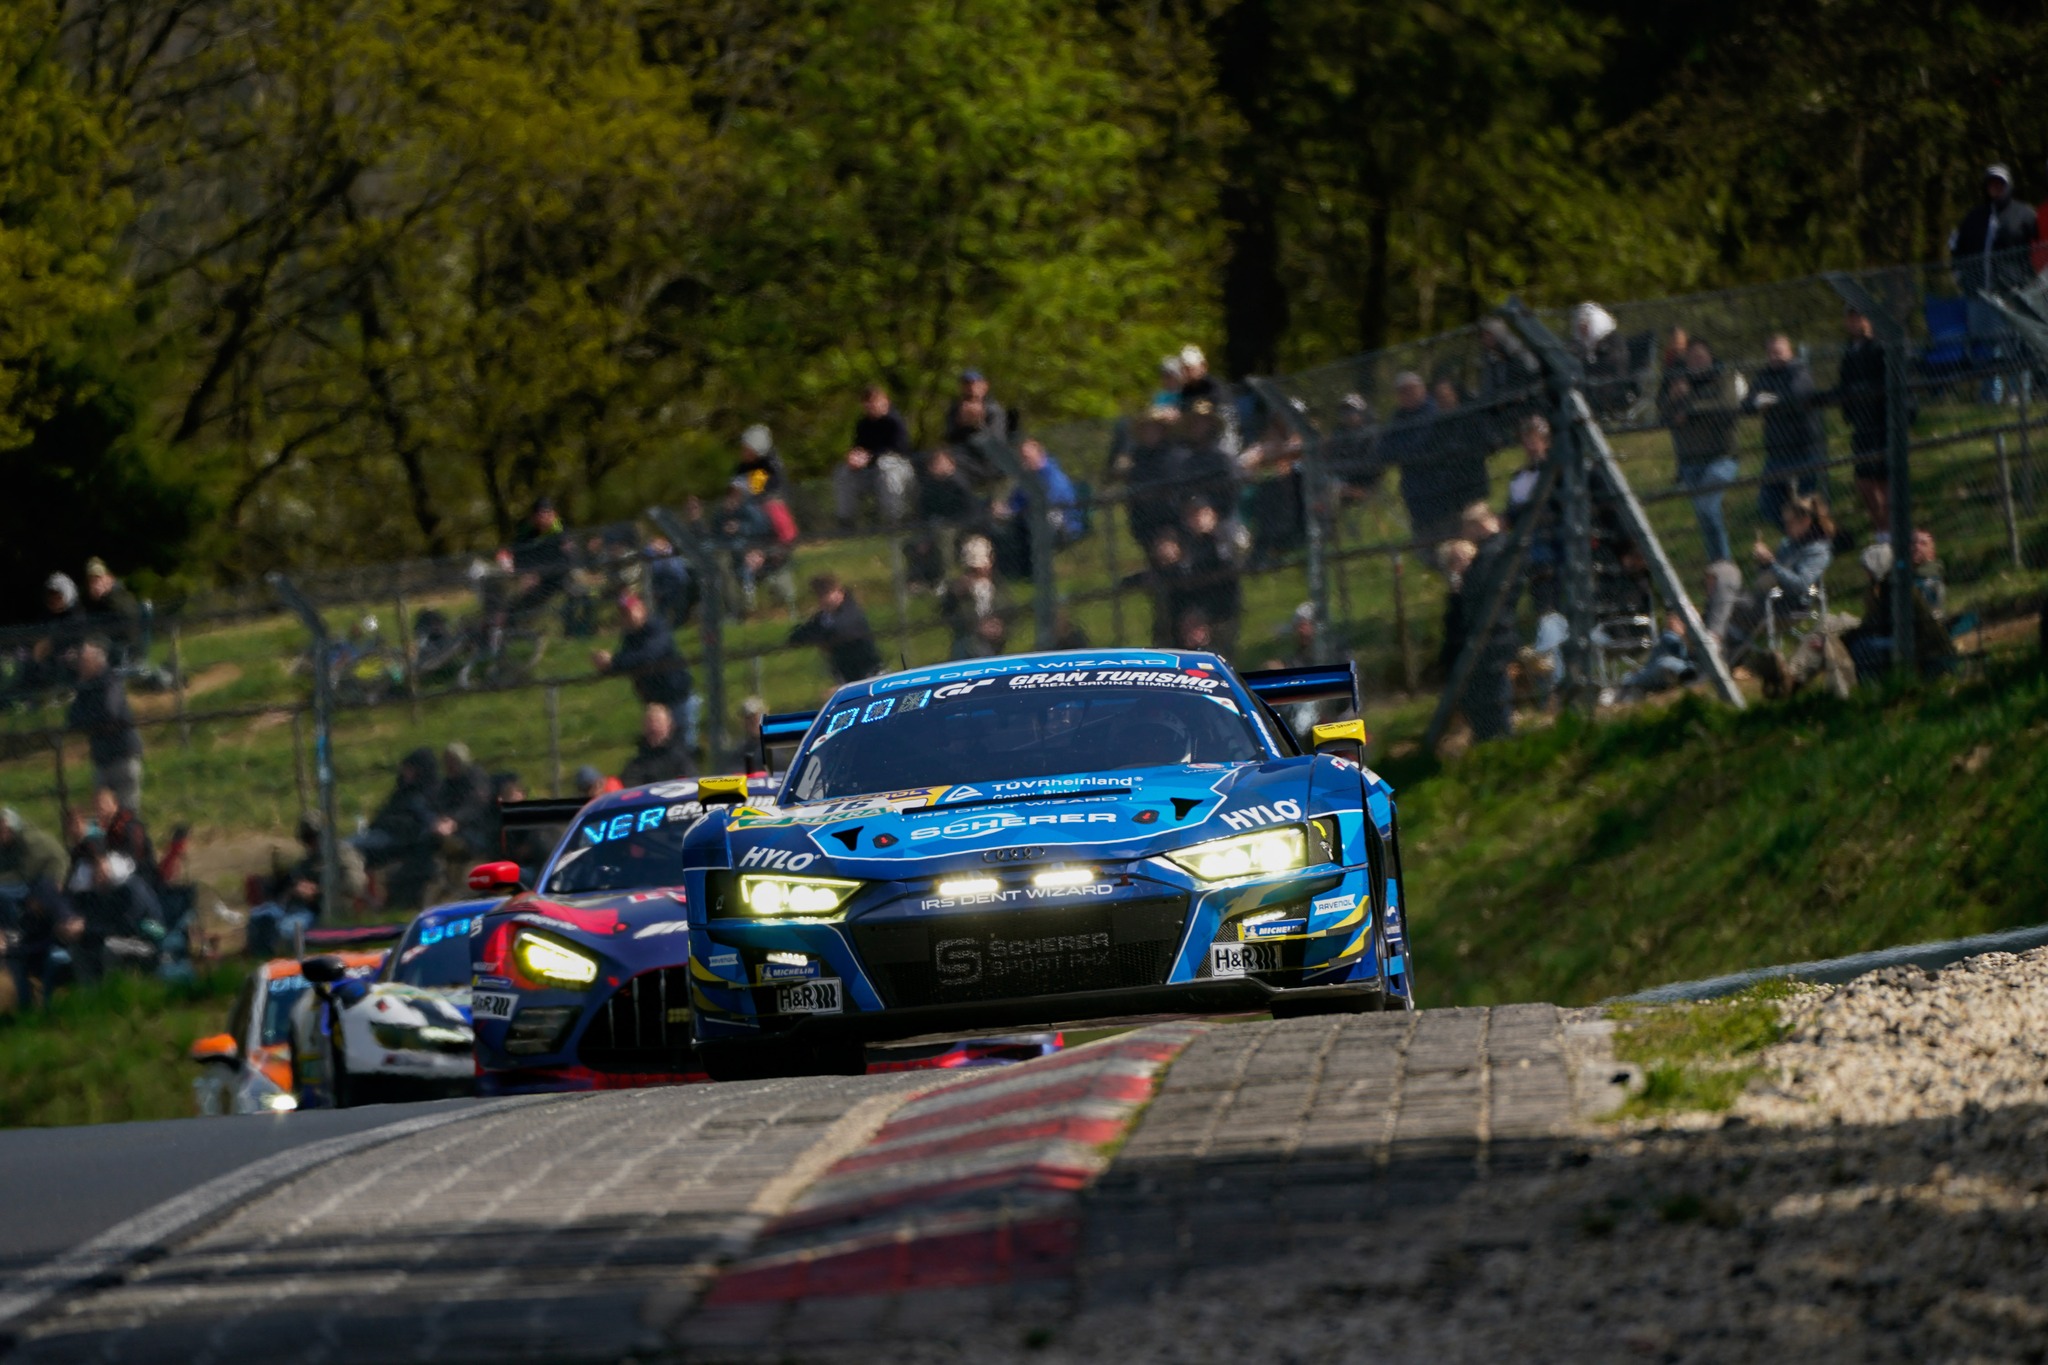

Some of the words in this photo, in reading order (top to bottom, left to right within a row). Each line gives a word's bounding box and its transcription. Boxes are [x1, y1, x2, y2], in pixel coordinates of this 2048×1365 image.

[881, 675, 931, 689] IRS
[939, 664, 1031, 680] DENT
[1037, 659, 1168, 669] WIZARD
[1008, 671, 1090, 686] GRAN
[1137, 681, 1213, 693] SIMULATOR
[824, 799, 874, 814] 16
[1025, 796, 1118, 806] WIZARD
[582, 805, 666, 844] VER
[911, 813, 1117, 840] SCHERER
[921, 895, 955, 911] IRS
[960, 889, 1022, 905] DENT
[1026, 884, 1114, 899] WIZARD
[1318, 898, 1353, 910] RAVENOL
[1258, 924, 1302, 936] MICHELIN
[989, 932, 1110, 957] SCHERER
[773, 967, 815, 977] MICHELIN
